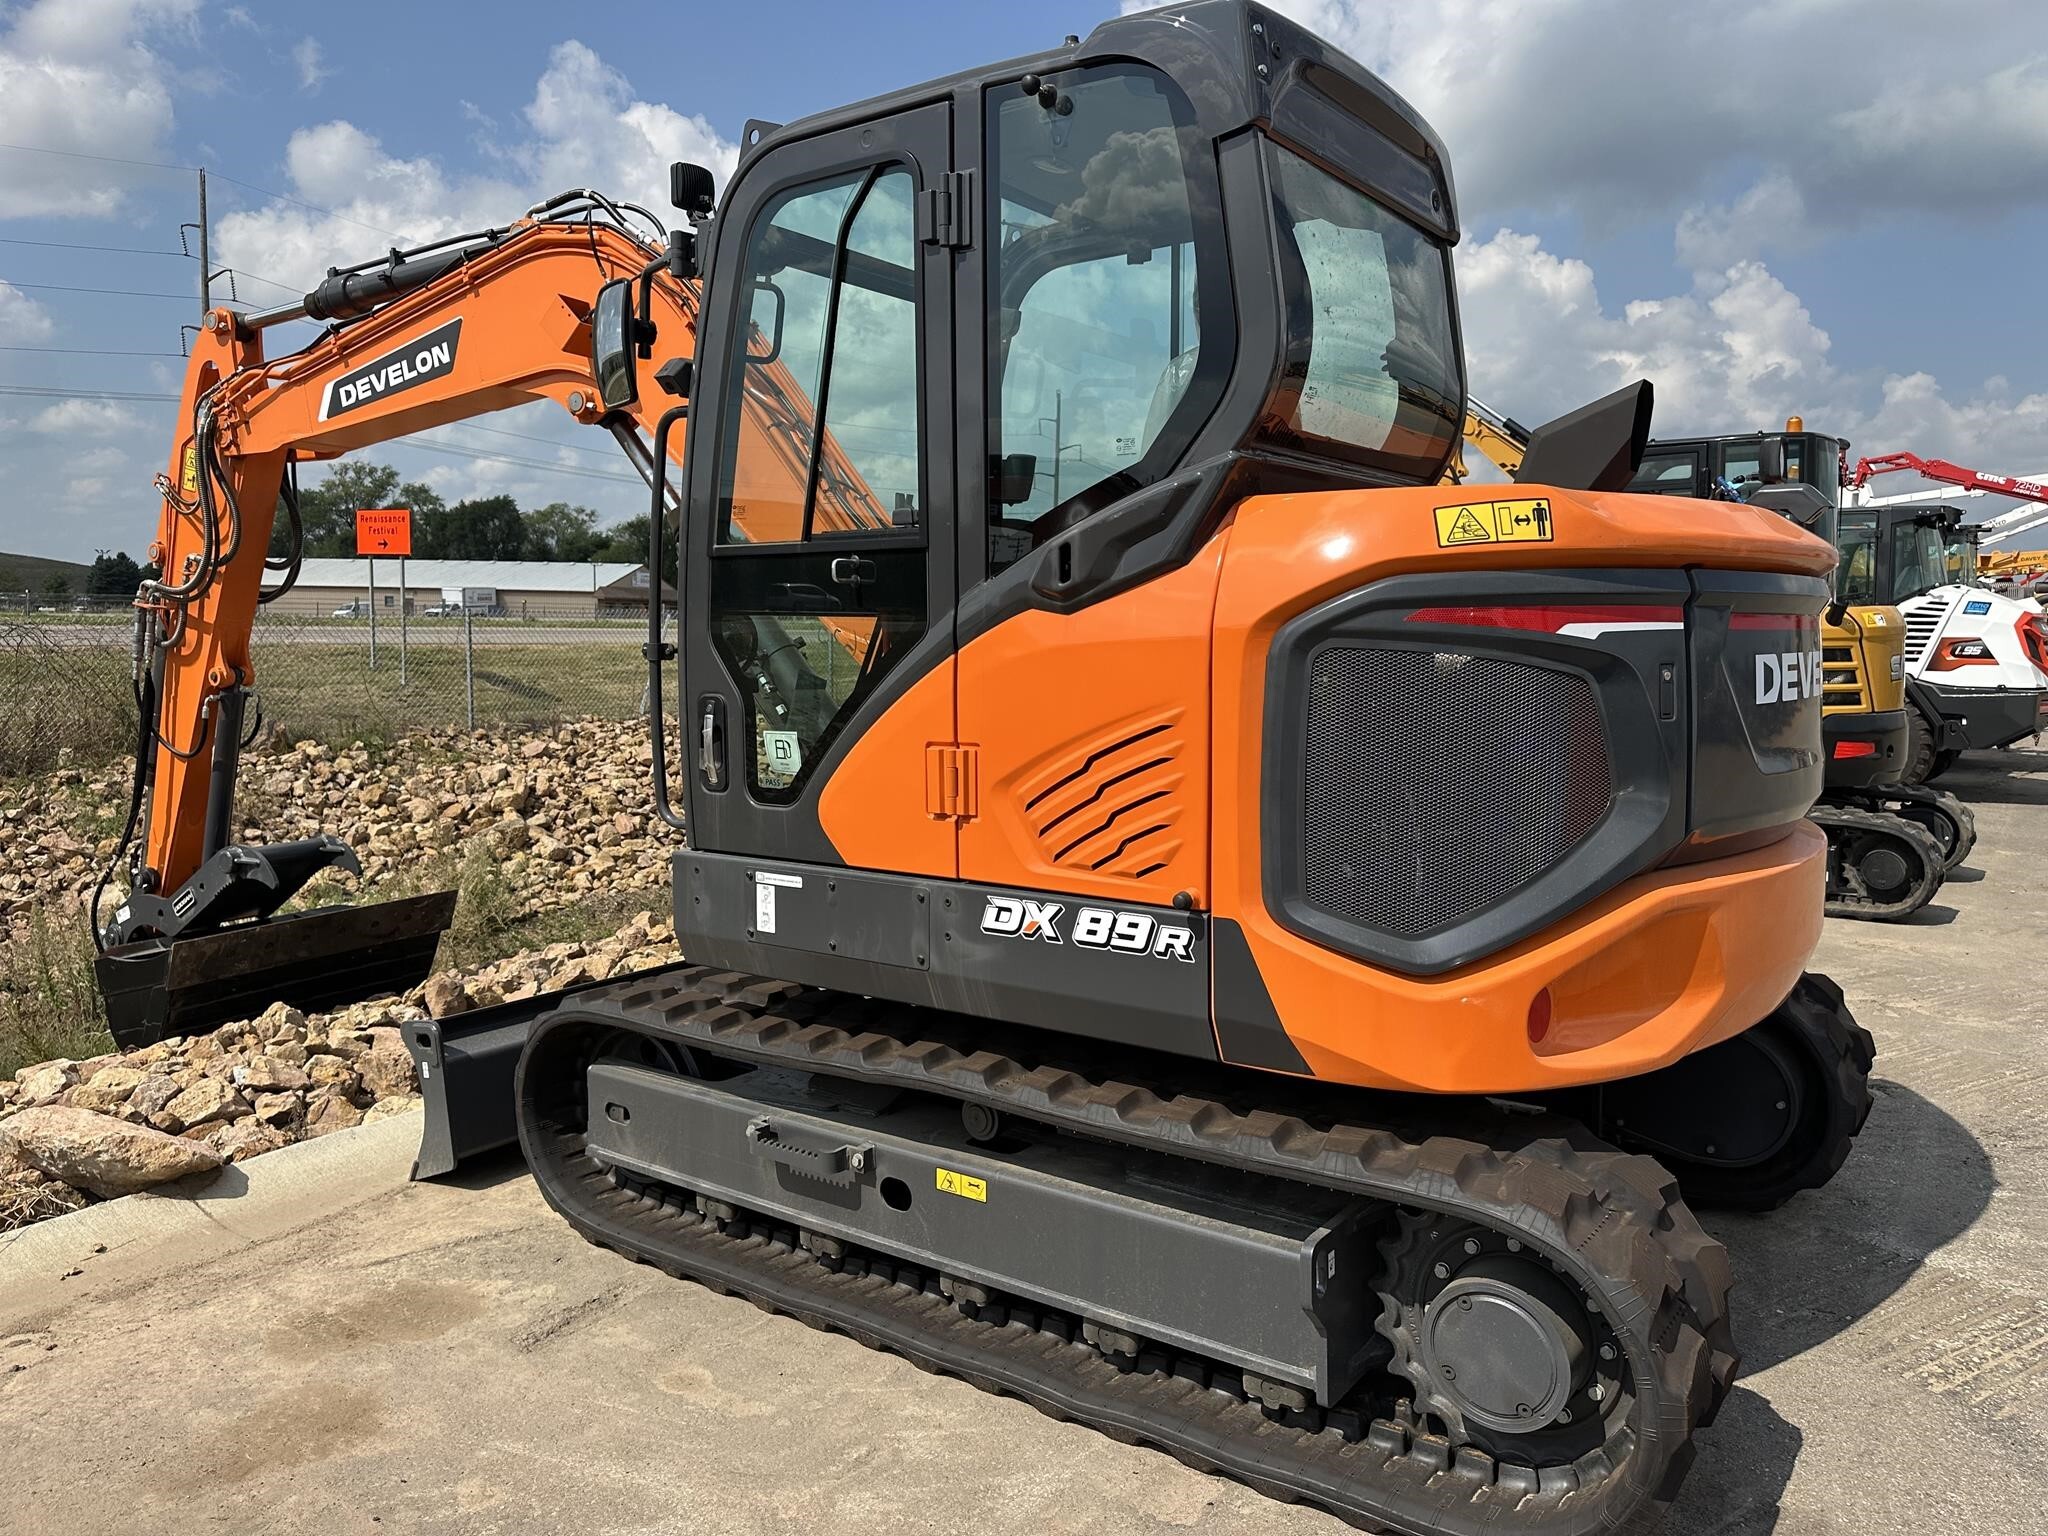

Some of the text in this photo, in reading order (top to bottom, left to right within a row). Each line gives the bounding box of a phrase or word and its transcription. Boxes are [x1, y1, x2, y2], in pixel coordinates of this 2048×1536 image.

[338, 341, 451, 408] DEVELON
[2015, 480, 2041, 491] 72HD
[360, 515, 406, 523] Renaissance
[368, 526, 398, 535] Festival
[1755, 651, 1823, 705] DEVE
[765, 778, 781, 787] PASS
[980, 895, 1066, 944] DX
